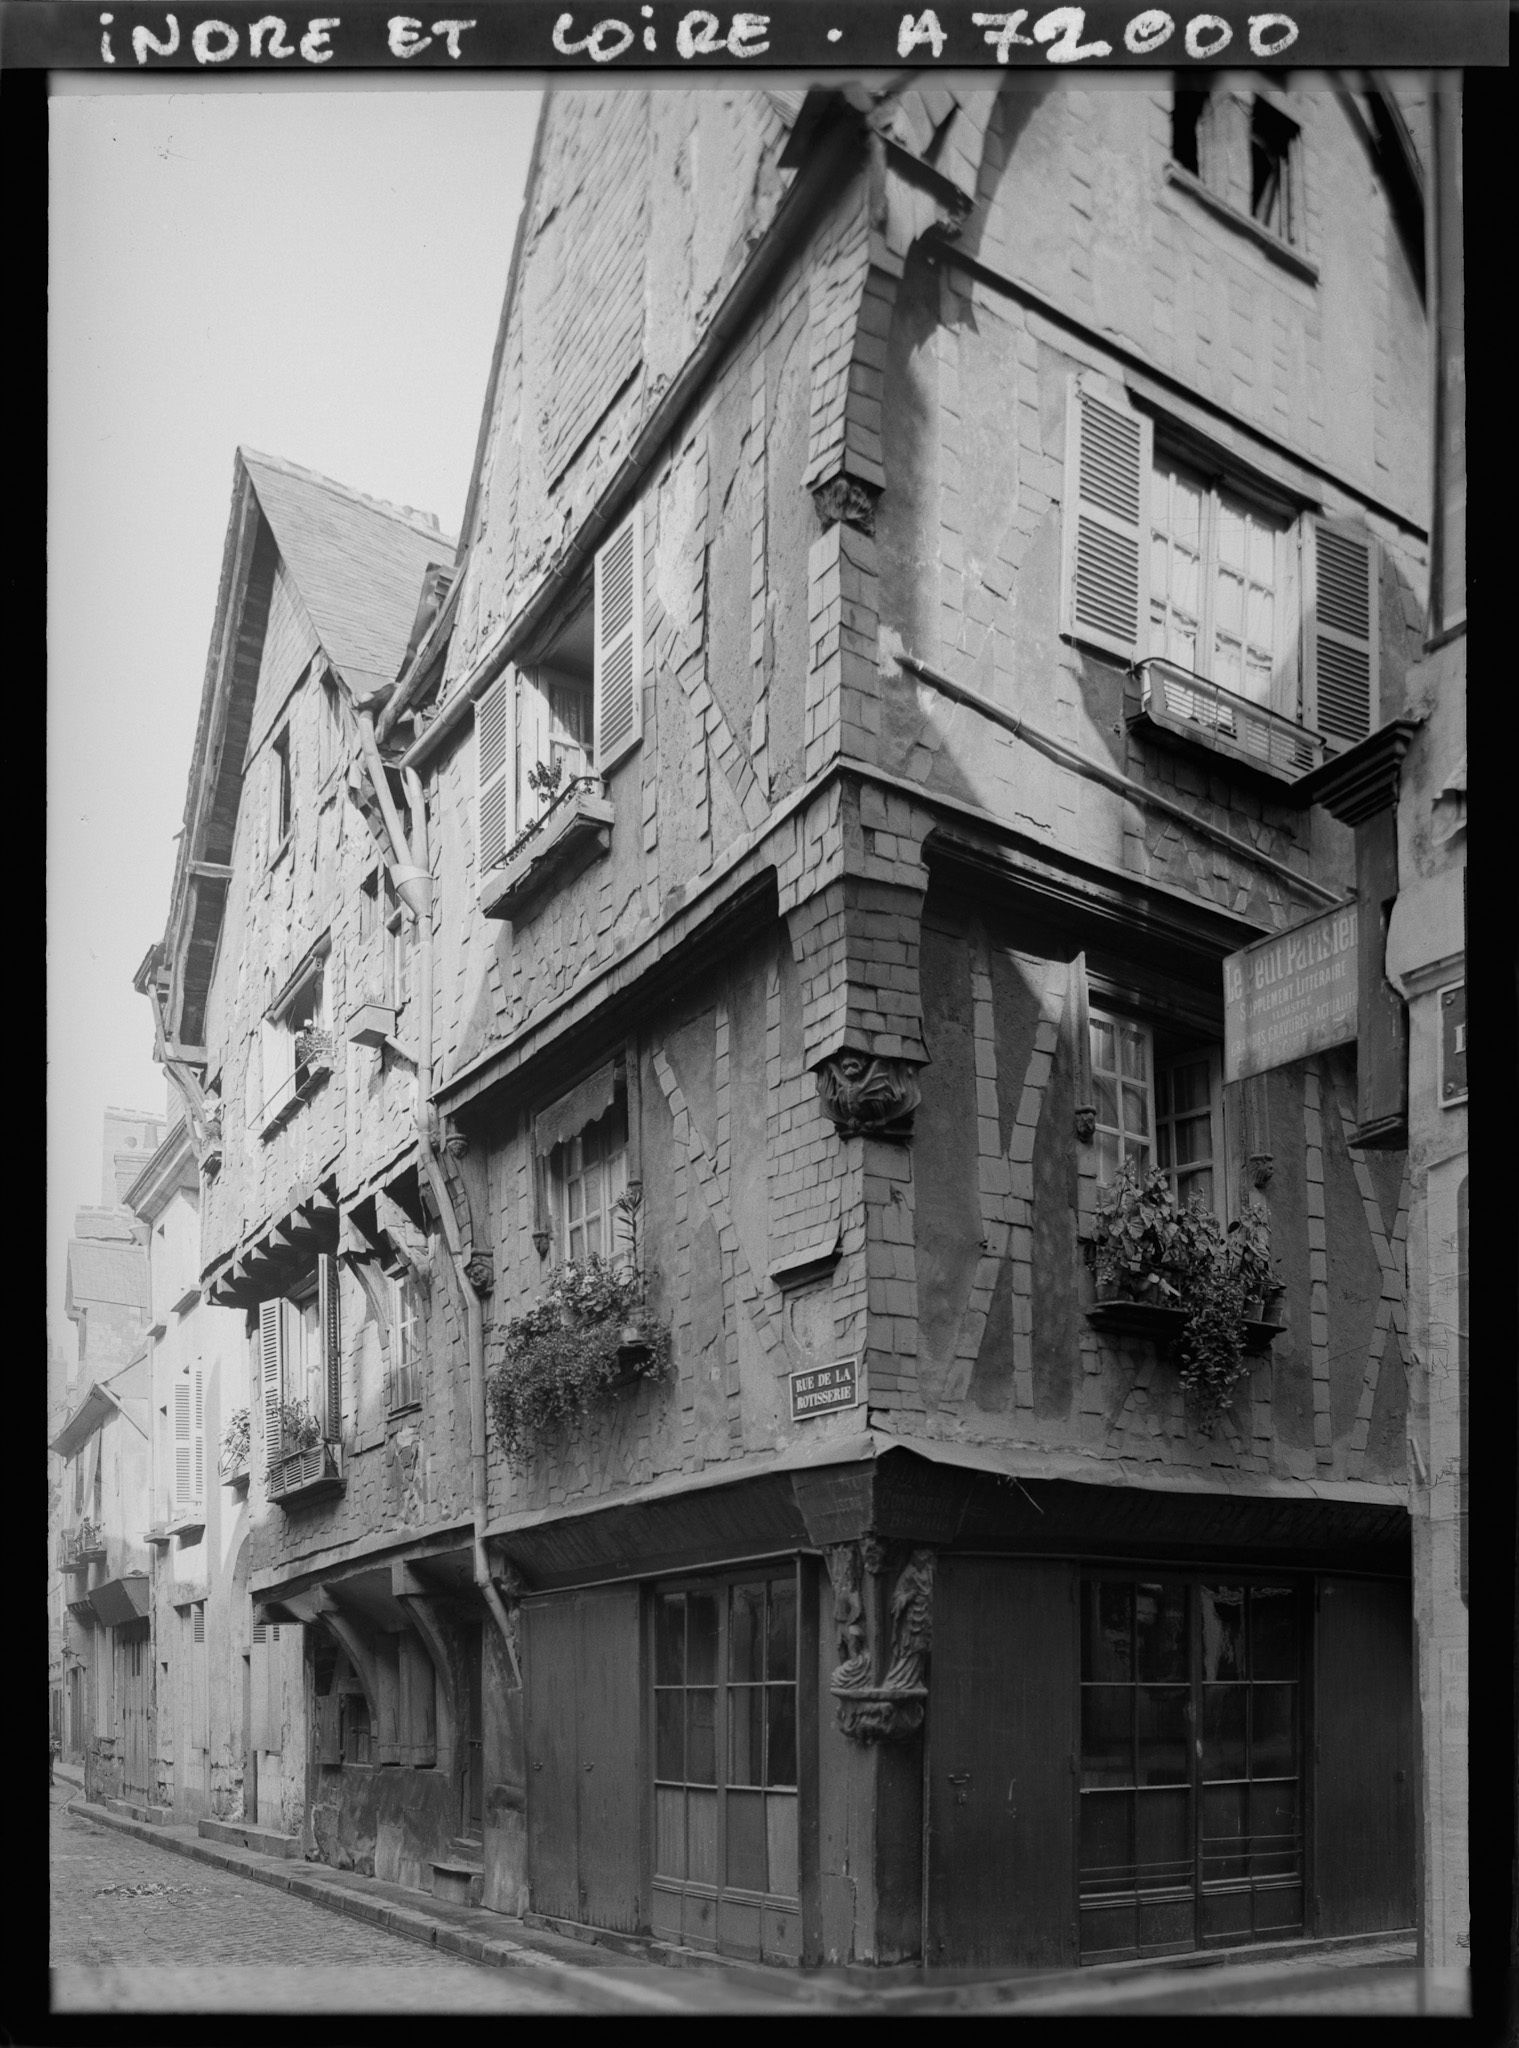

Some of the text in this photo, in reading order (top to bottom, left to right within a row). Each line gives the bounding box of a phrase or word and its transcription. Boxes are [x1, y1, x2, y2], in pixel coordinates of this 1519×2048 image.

[1224, 964, 1243, 1004] Le
[1285, 913, 1358, 976] Parisien
[795, 1368, 852, 1393] RUE DE LA
[796, 1386, 852, 1410] ROTISSERIE
